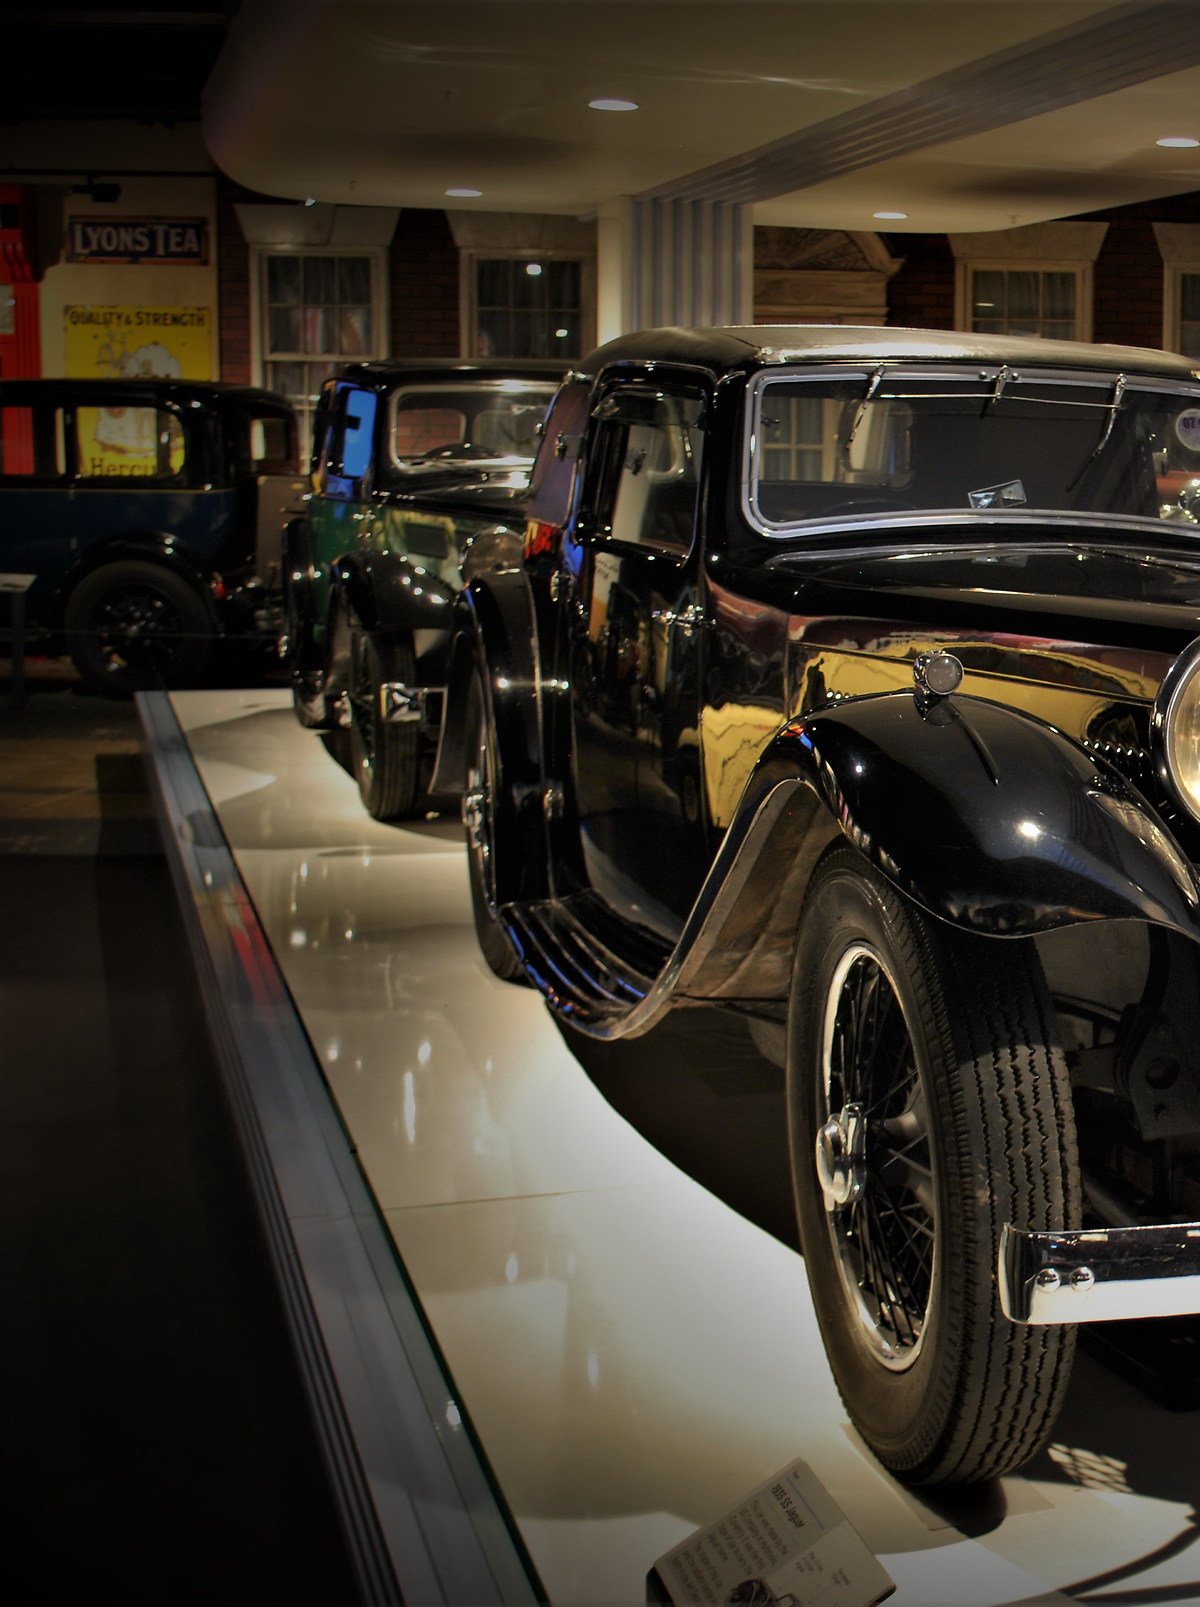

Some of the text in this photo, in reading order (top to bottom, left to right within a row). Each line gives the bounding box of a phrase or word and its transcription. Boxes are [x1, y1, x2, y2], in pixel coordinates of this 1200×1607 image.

[153, 224, 200, 255] TEA
[70, 310, 123, 327] QUALITY
[135, 311, 206, 327] STRENGTH
[91, 457, 156, 477] Hercu
